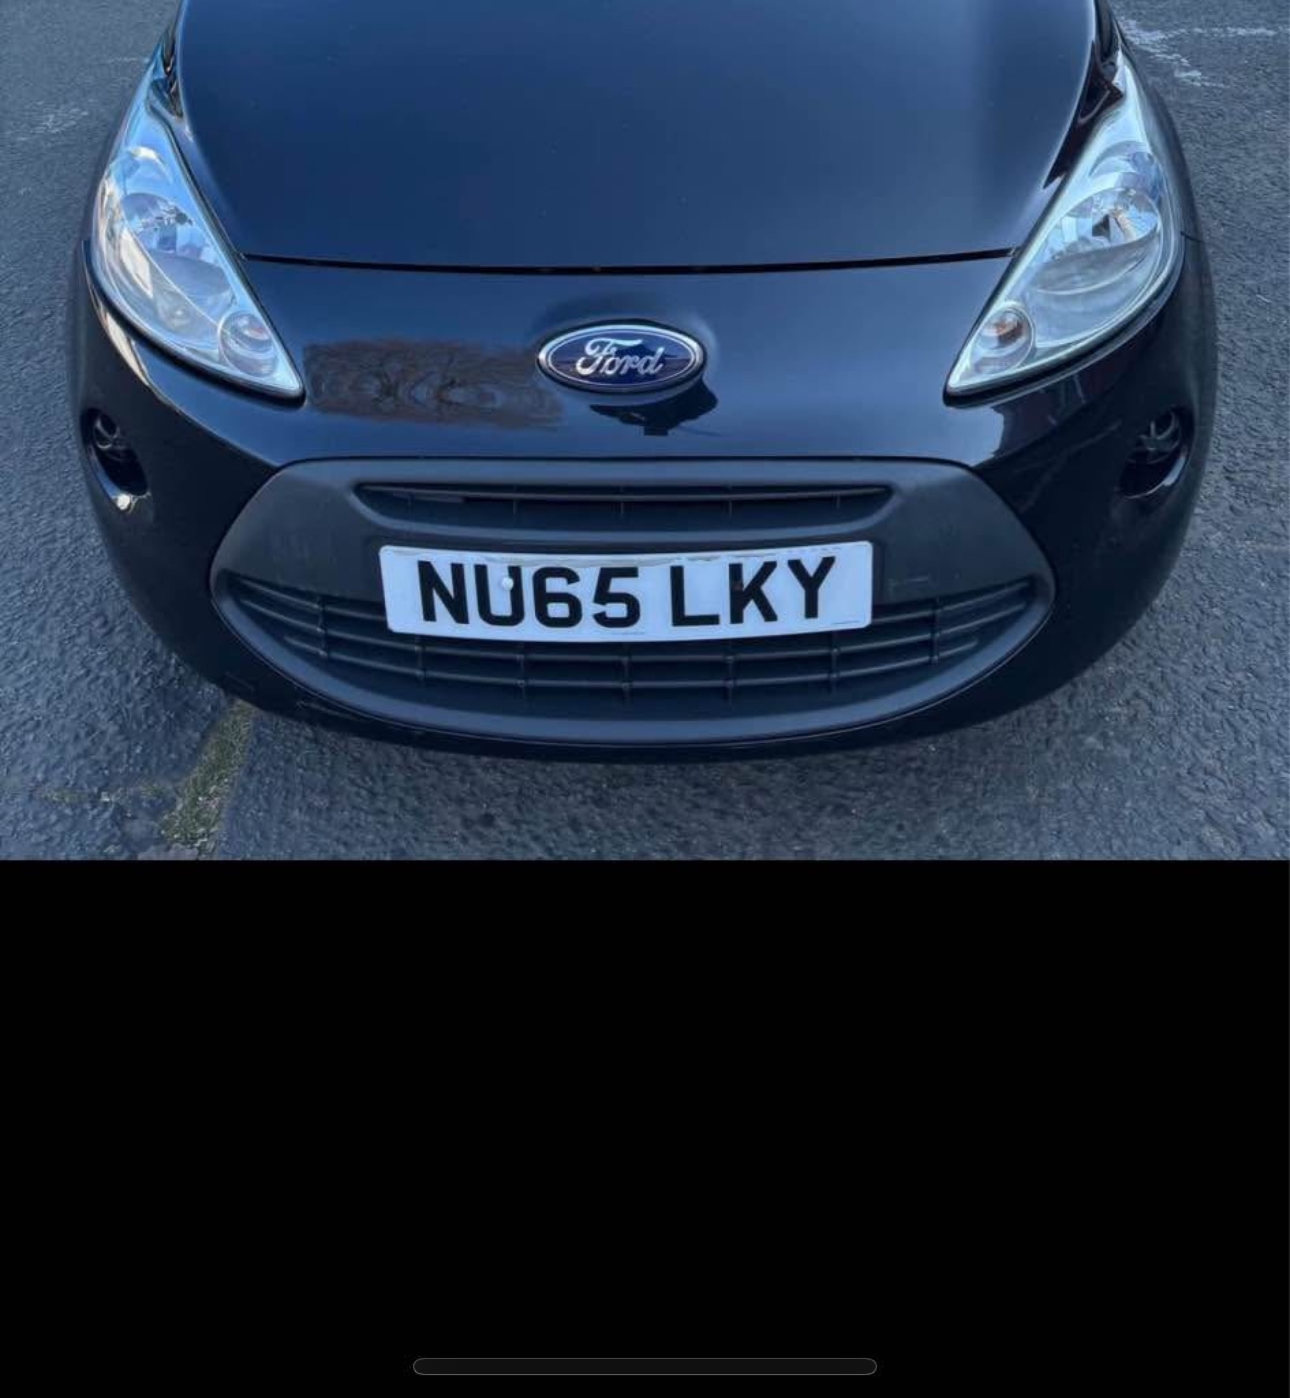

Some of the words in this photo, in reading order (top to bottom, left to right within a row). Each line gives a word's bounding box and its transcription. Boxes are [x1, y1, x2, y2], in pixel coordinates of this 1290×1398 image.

[575, 338, 664, 376] Ford
[417, 559, 642, 629] NU65
[670, 556, 836, 628] LKY
